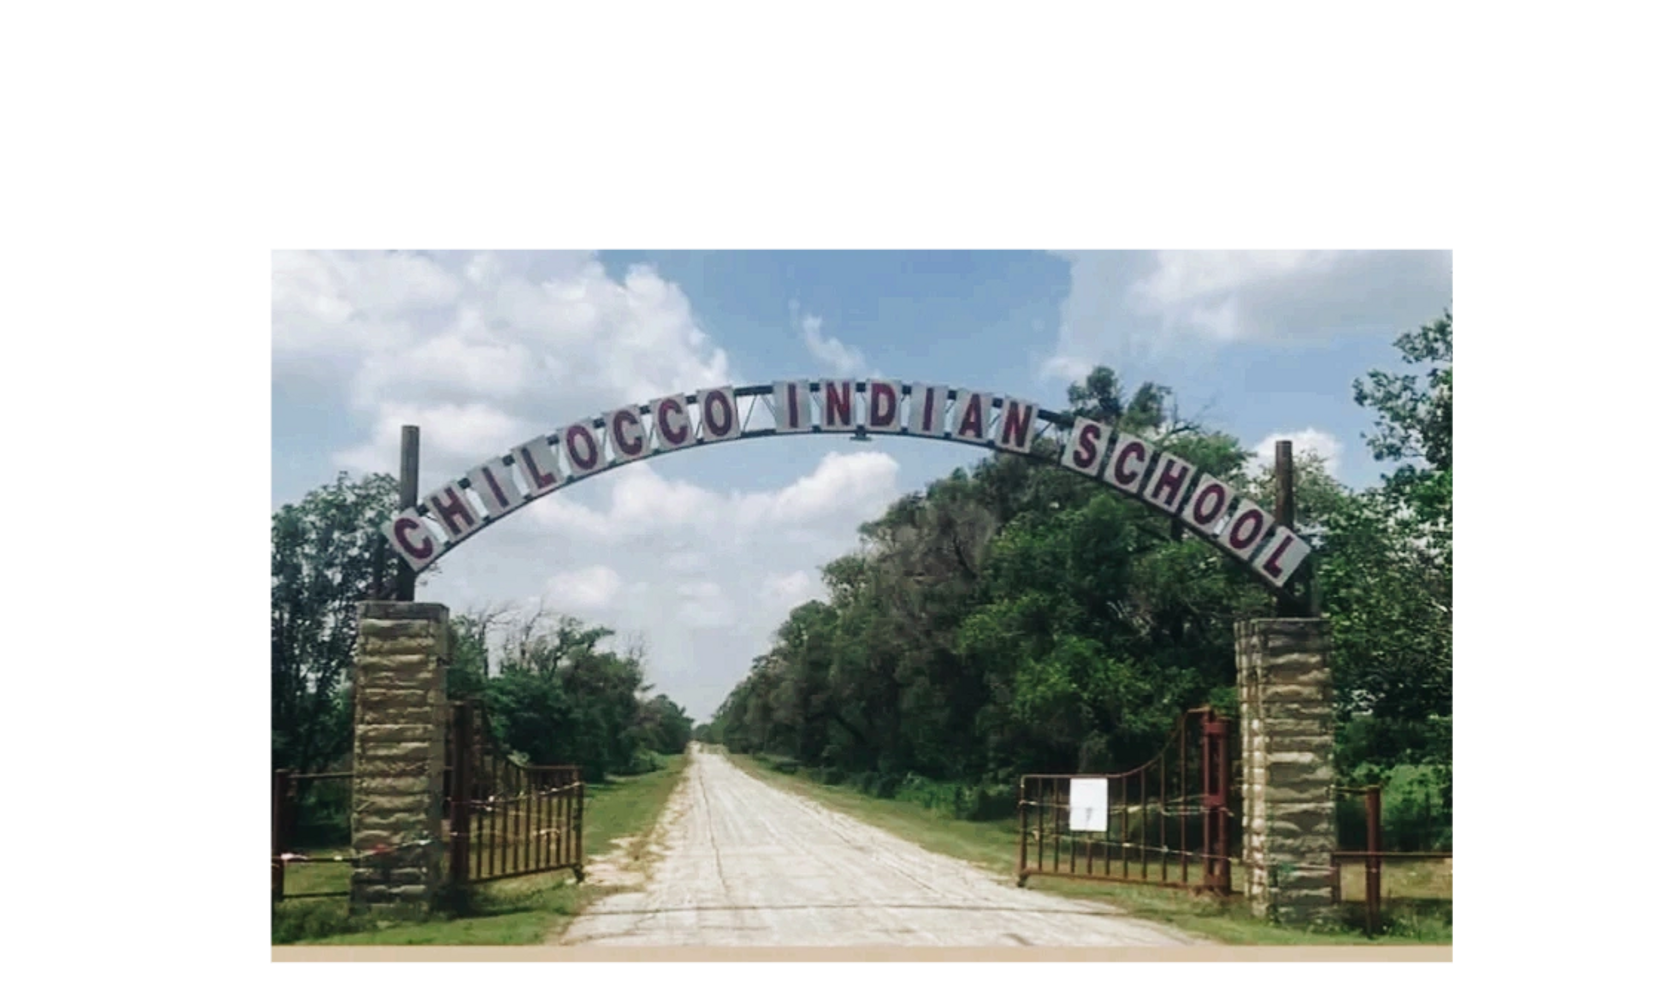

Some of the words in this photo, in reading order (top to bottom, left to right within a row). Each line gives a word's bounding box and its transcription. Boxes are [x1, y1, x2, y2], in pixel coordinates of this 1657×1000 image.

[393, 389, 732, 559] CHILOCCO
[787, 382, 1032, 447] INDIAN
[1073, 424, 1294, 578] SCHOOL
